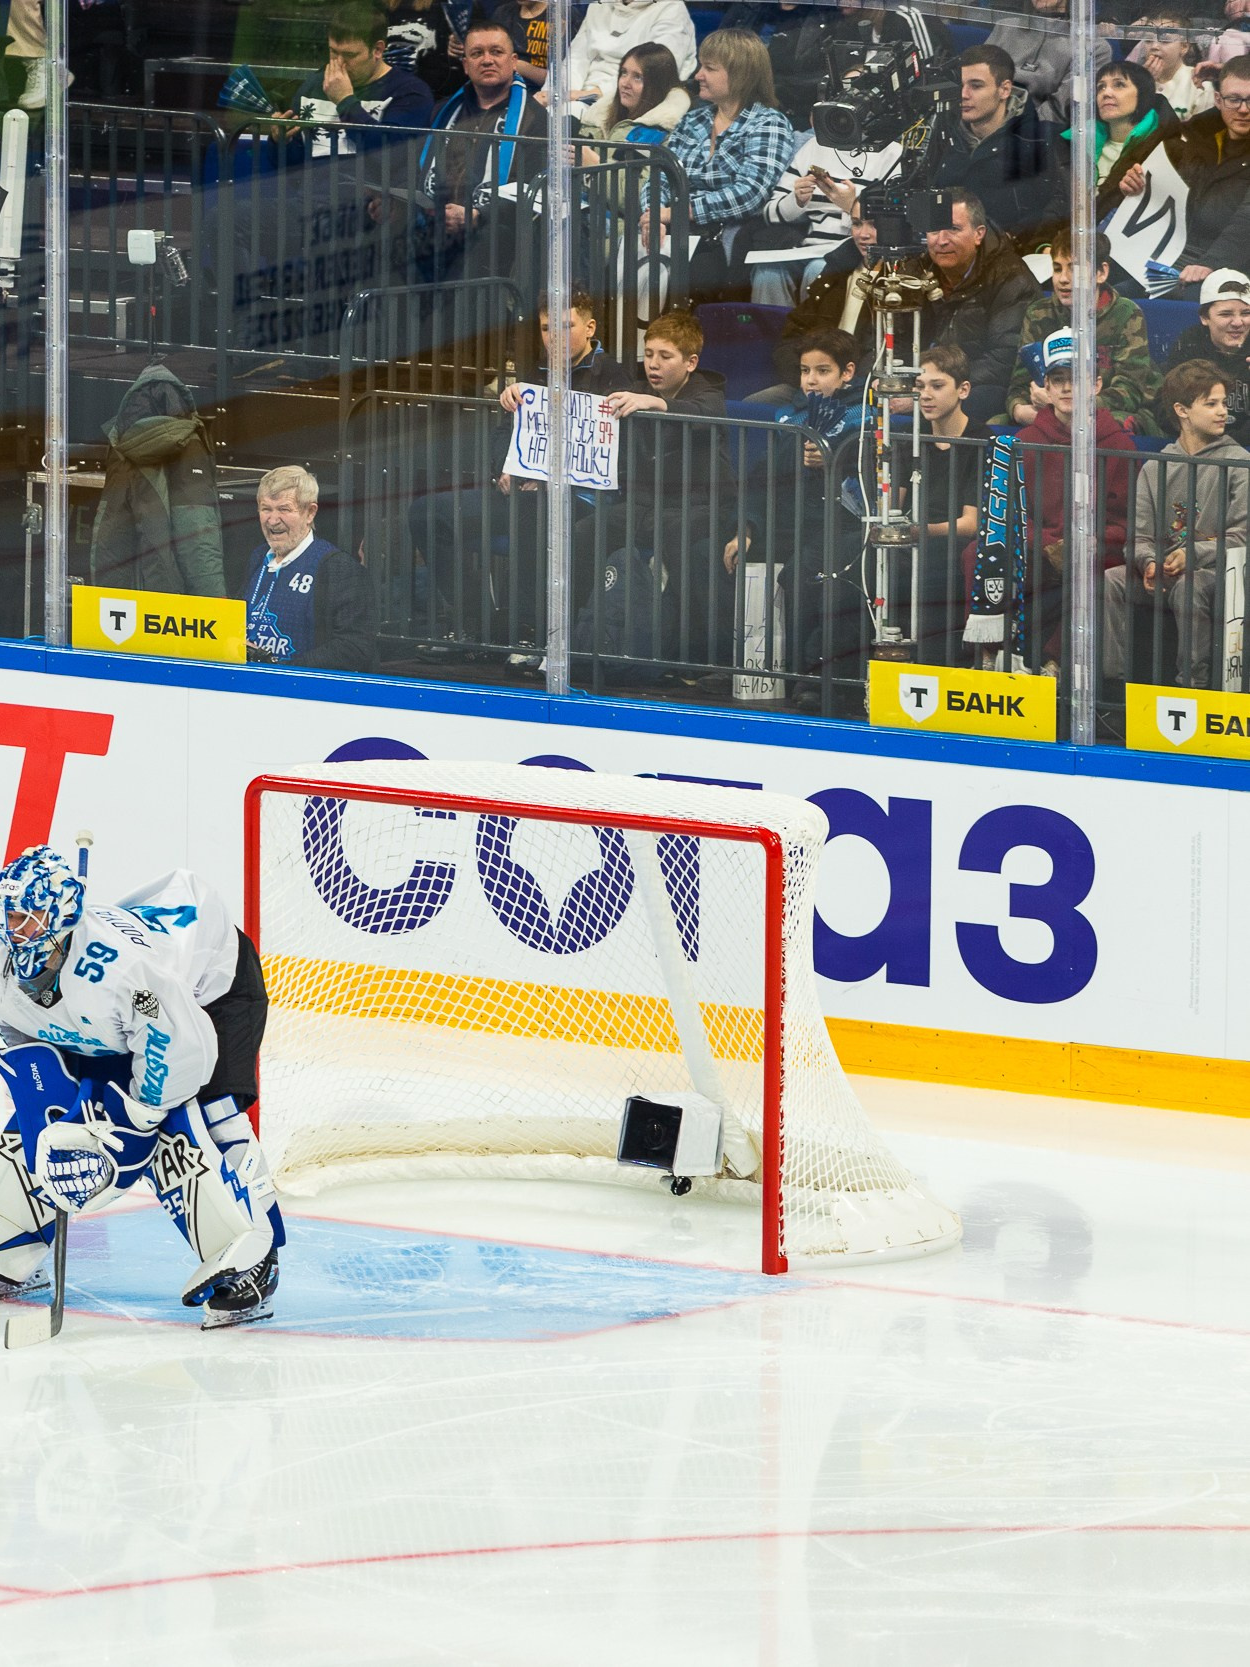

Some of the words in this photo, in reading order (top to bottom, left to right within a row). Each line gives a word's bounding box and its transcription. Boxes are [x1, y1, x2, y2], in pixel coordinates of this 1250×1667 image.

[599, 421, 613, 445] 97
[288, 572, 314, 593] 48
[144, 613, 217, 640] БАНК
[947, 690, 1025, 717] БАНК
[1206, 713, 1250, 738] БА
[73, 941, 119, 984] 59
